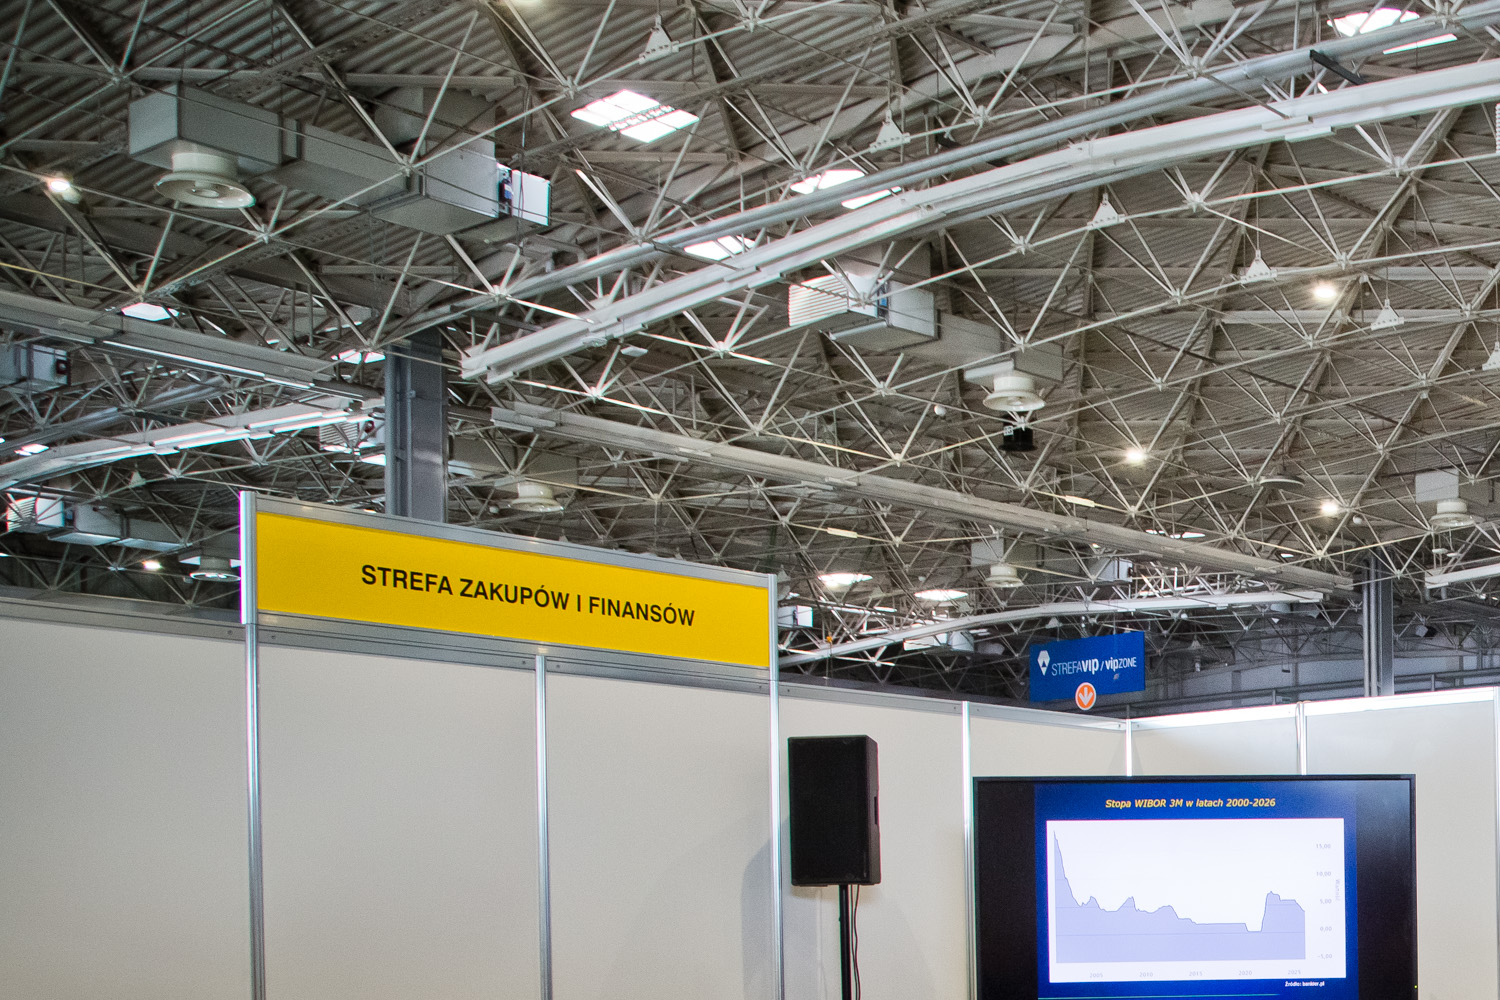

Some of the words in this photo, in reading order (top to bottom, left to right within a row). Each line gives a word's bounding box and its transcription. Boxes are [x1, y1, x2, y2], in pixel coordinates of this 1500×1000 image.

[361, 564, 453, 595] STREFA
[460, 577, 570, 611] ZAKUPÓW
[576, 594, 582, 613] I
[589, 596, 695, 627] FINANSÓW
[1105, 799, 1132, 810] Stopa
[1135, 799, 1167, 808] WIBOR
[1169, 798, 1184, 808] 3M
[1185, 800, 1194, 808] w
[1196, 798, 1224, 808] latach
[1226, 798, 1276, 808] 2000-2026
